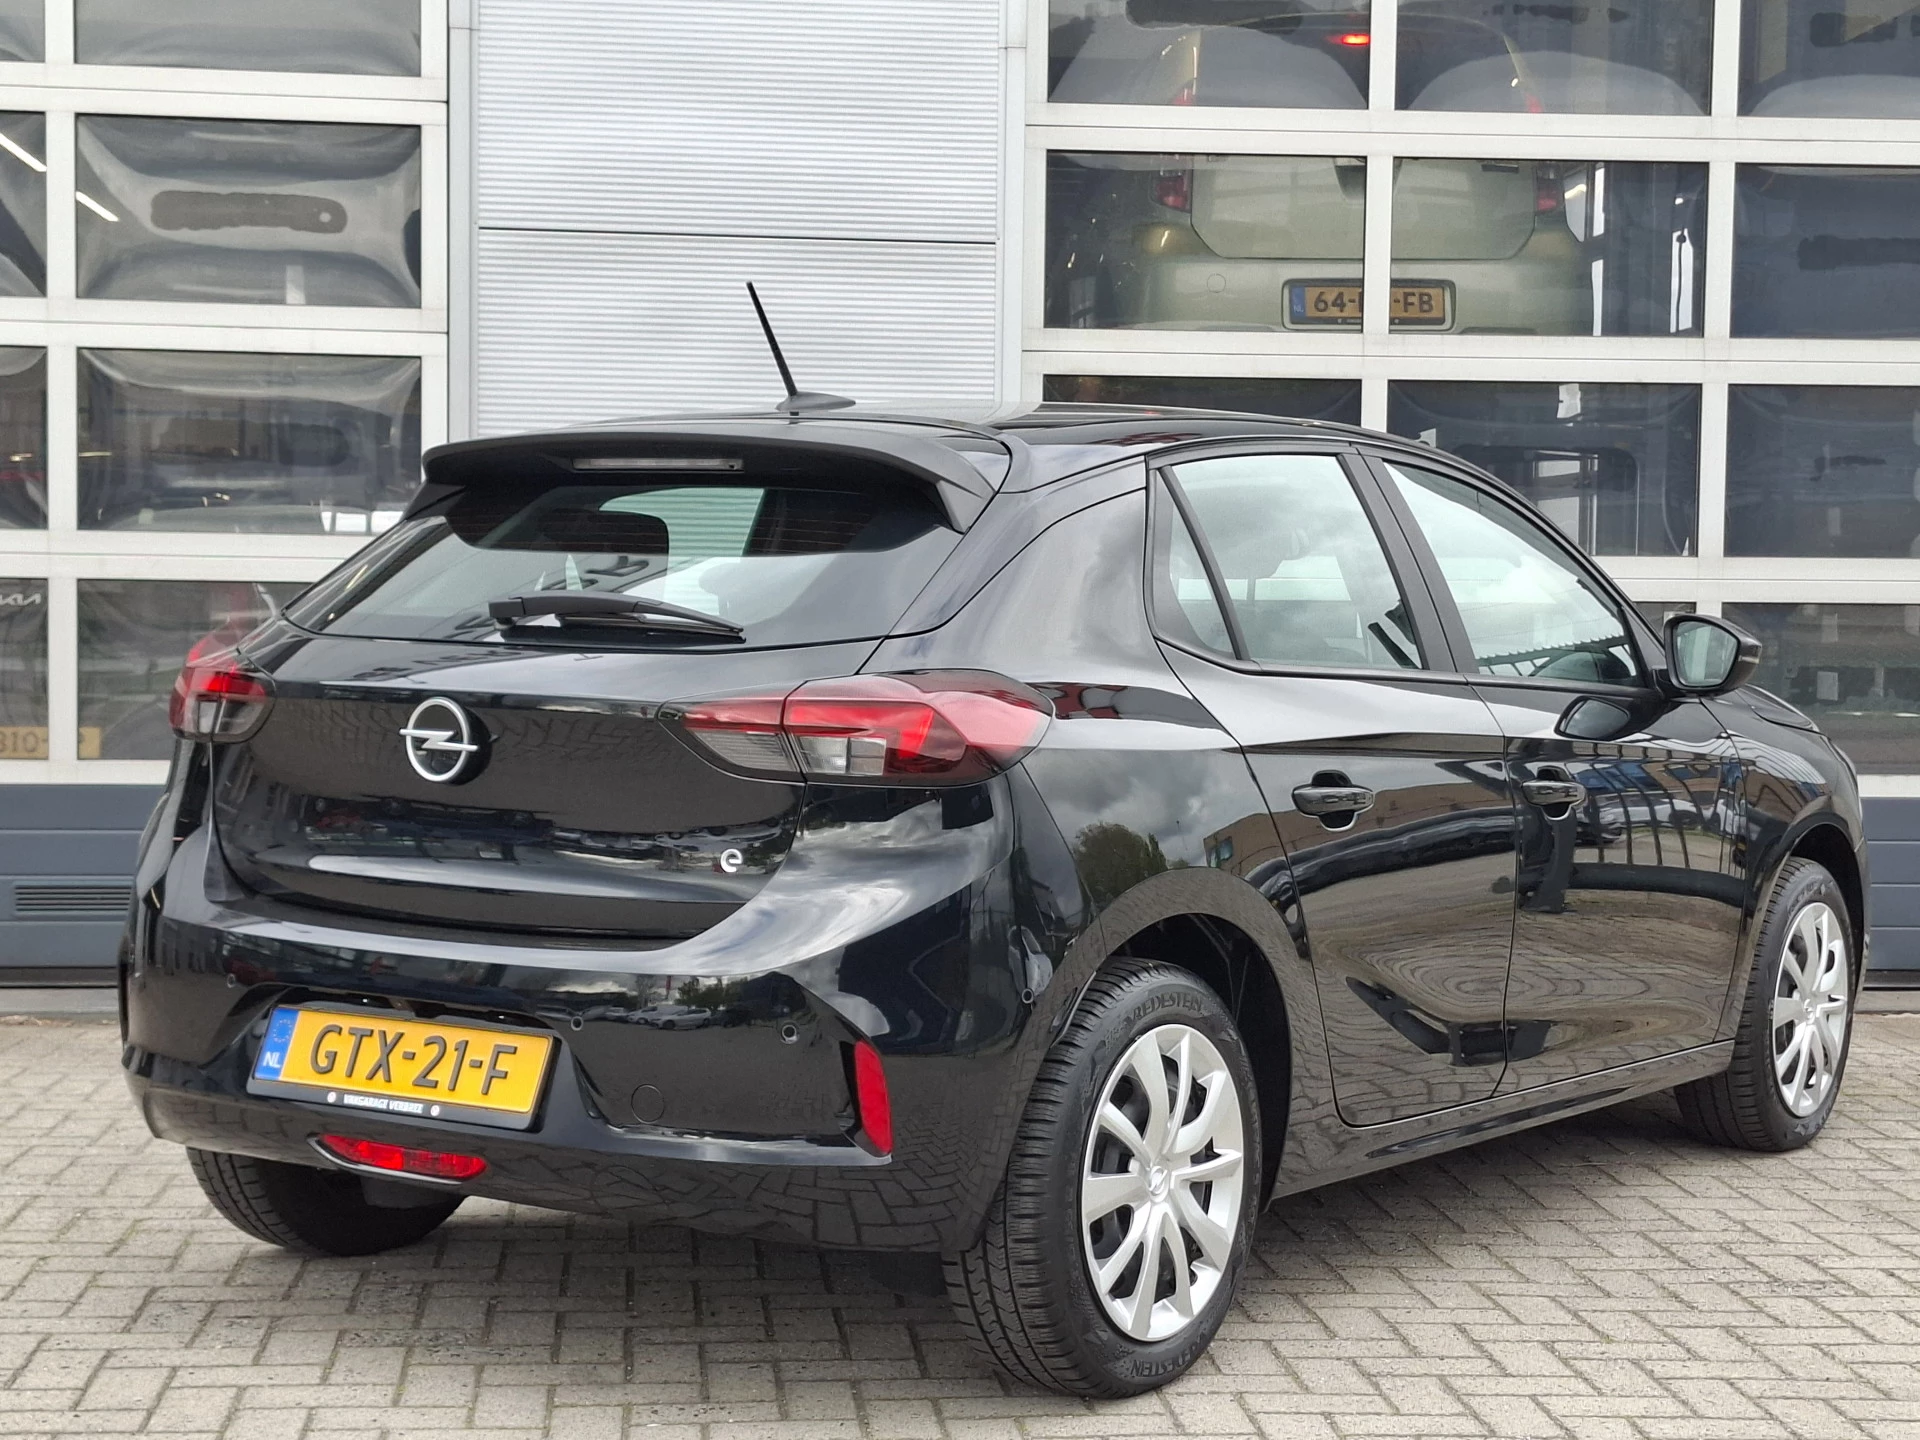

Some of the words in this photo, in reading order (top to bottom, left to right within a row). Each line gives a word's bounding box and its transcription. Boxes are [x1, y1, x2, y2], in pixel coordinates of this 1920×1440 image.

[1313, 291, 1434, 313] 64--FB
[720, 848, 744, 873] e
[263, 1051, 281, 1068] NL
[309, 1023, 518, 1096] GTX-21-F
